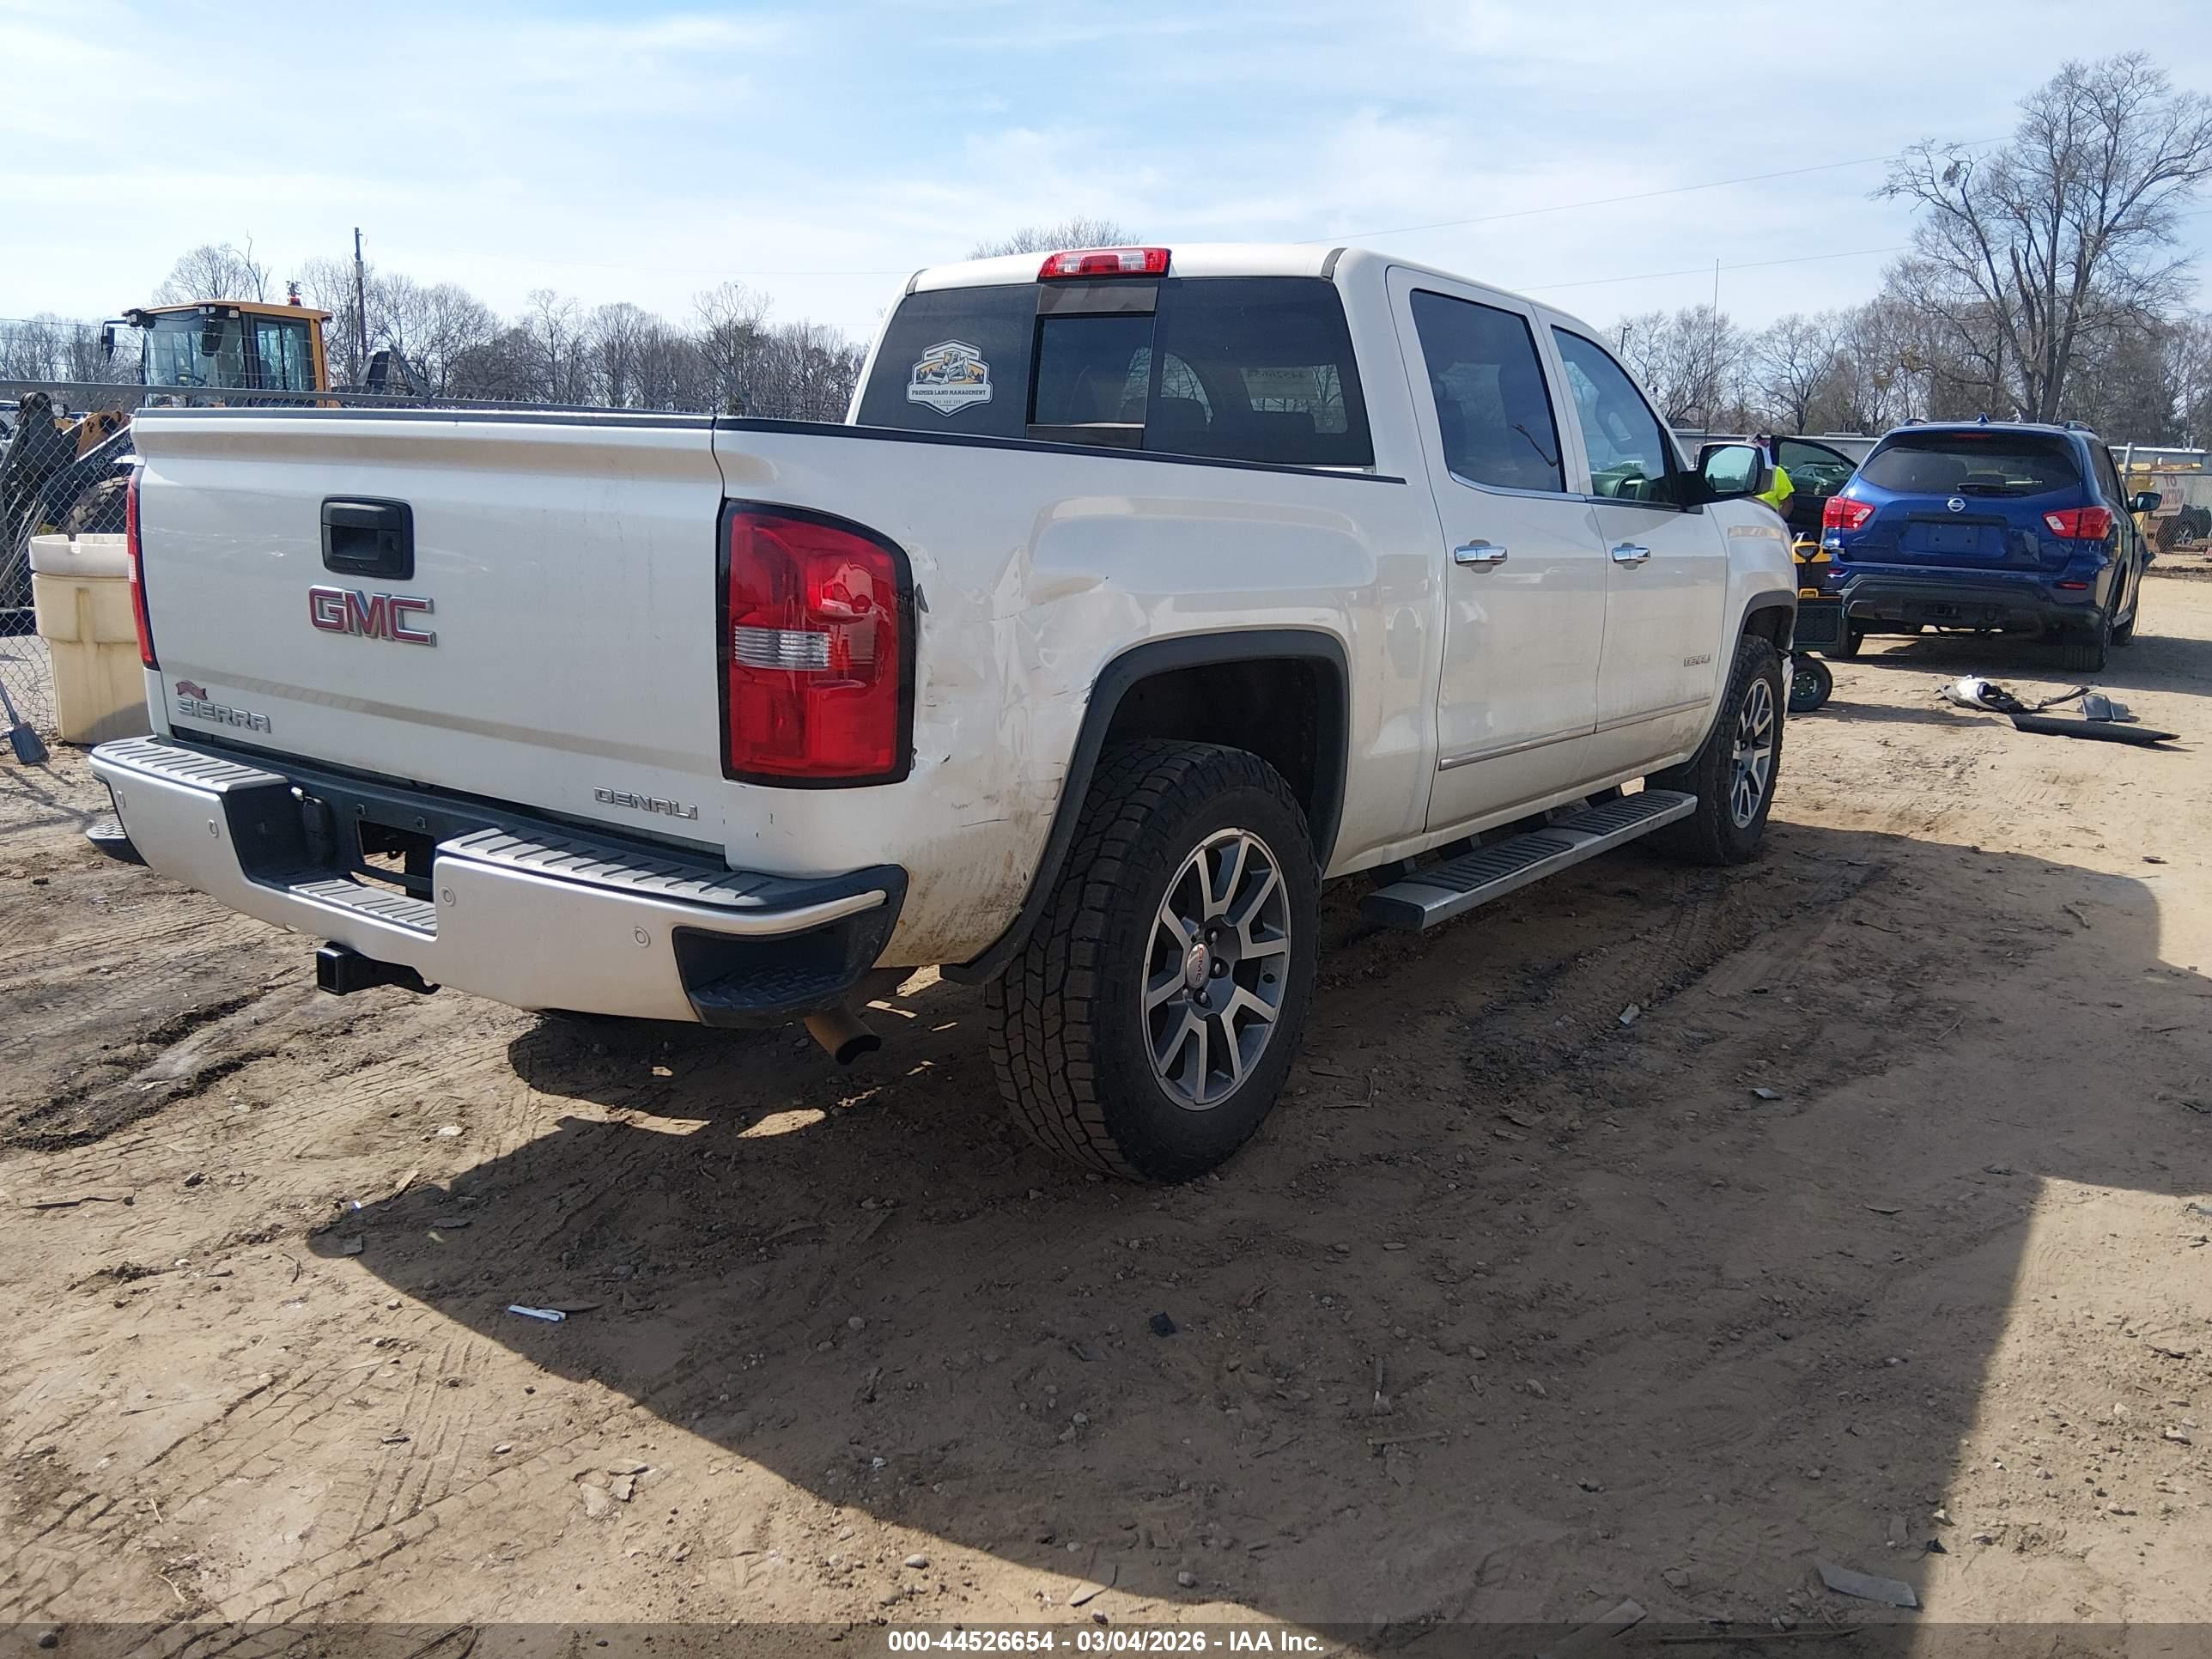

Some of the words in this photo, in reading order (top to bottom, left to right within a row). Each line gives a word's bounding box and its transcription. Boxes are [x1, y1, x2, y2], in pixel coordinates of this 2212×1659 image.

[2163, 475, 2178, 487] TO
[309, 585, 437, 647] GMC
[178, 696, 271, 733] SIERRA
[593, 786, 698, 820] DENALI
[1194, 947, 1204, 982] GMC
